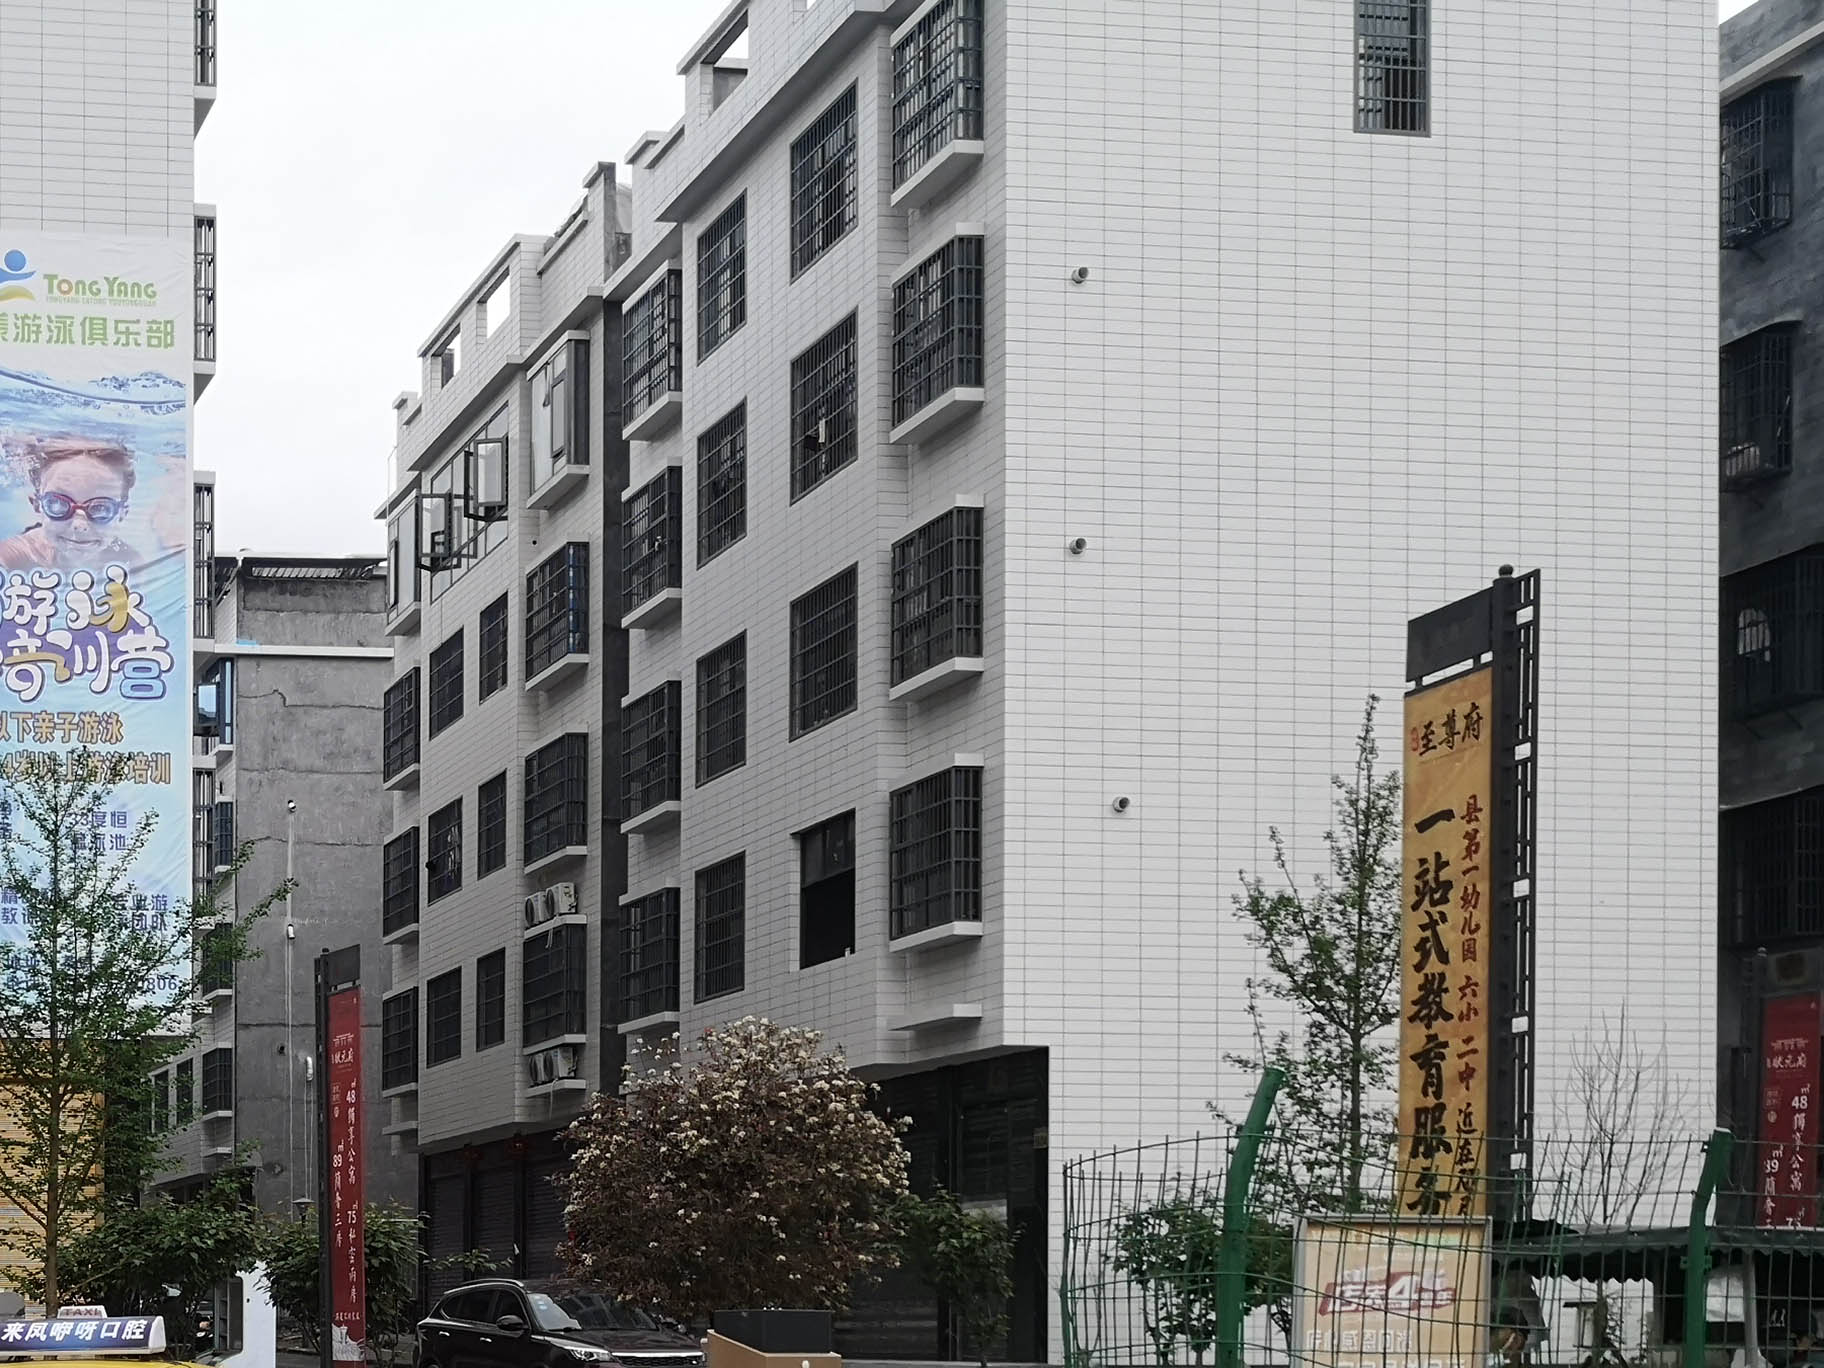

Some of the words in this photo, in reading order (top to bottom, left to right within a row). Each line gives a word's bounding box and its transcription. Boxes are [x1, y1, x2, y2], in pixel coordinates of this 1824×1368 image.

[1418, 701, 1484, 757] 至尊府
[1, 749, 172, 784] 4岁以上游泳培训
[62, 1307, 100, 1317] TAXI
